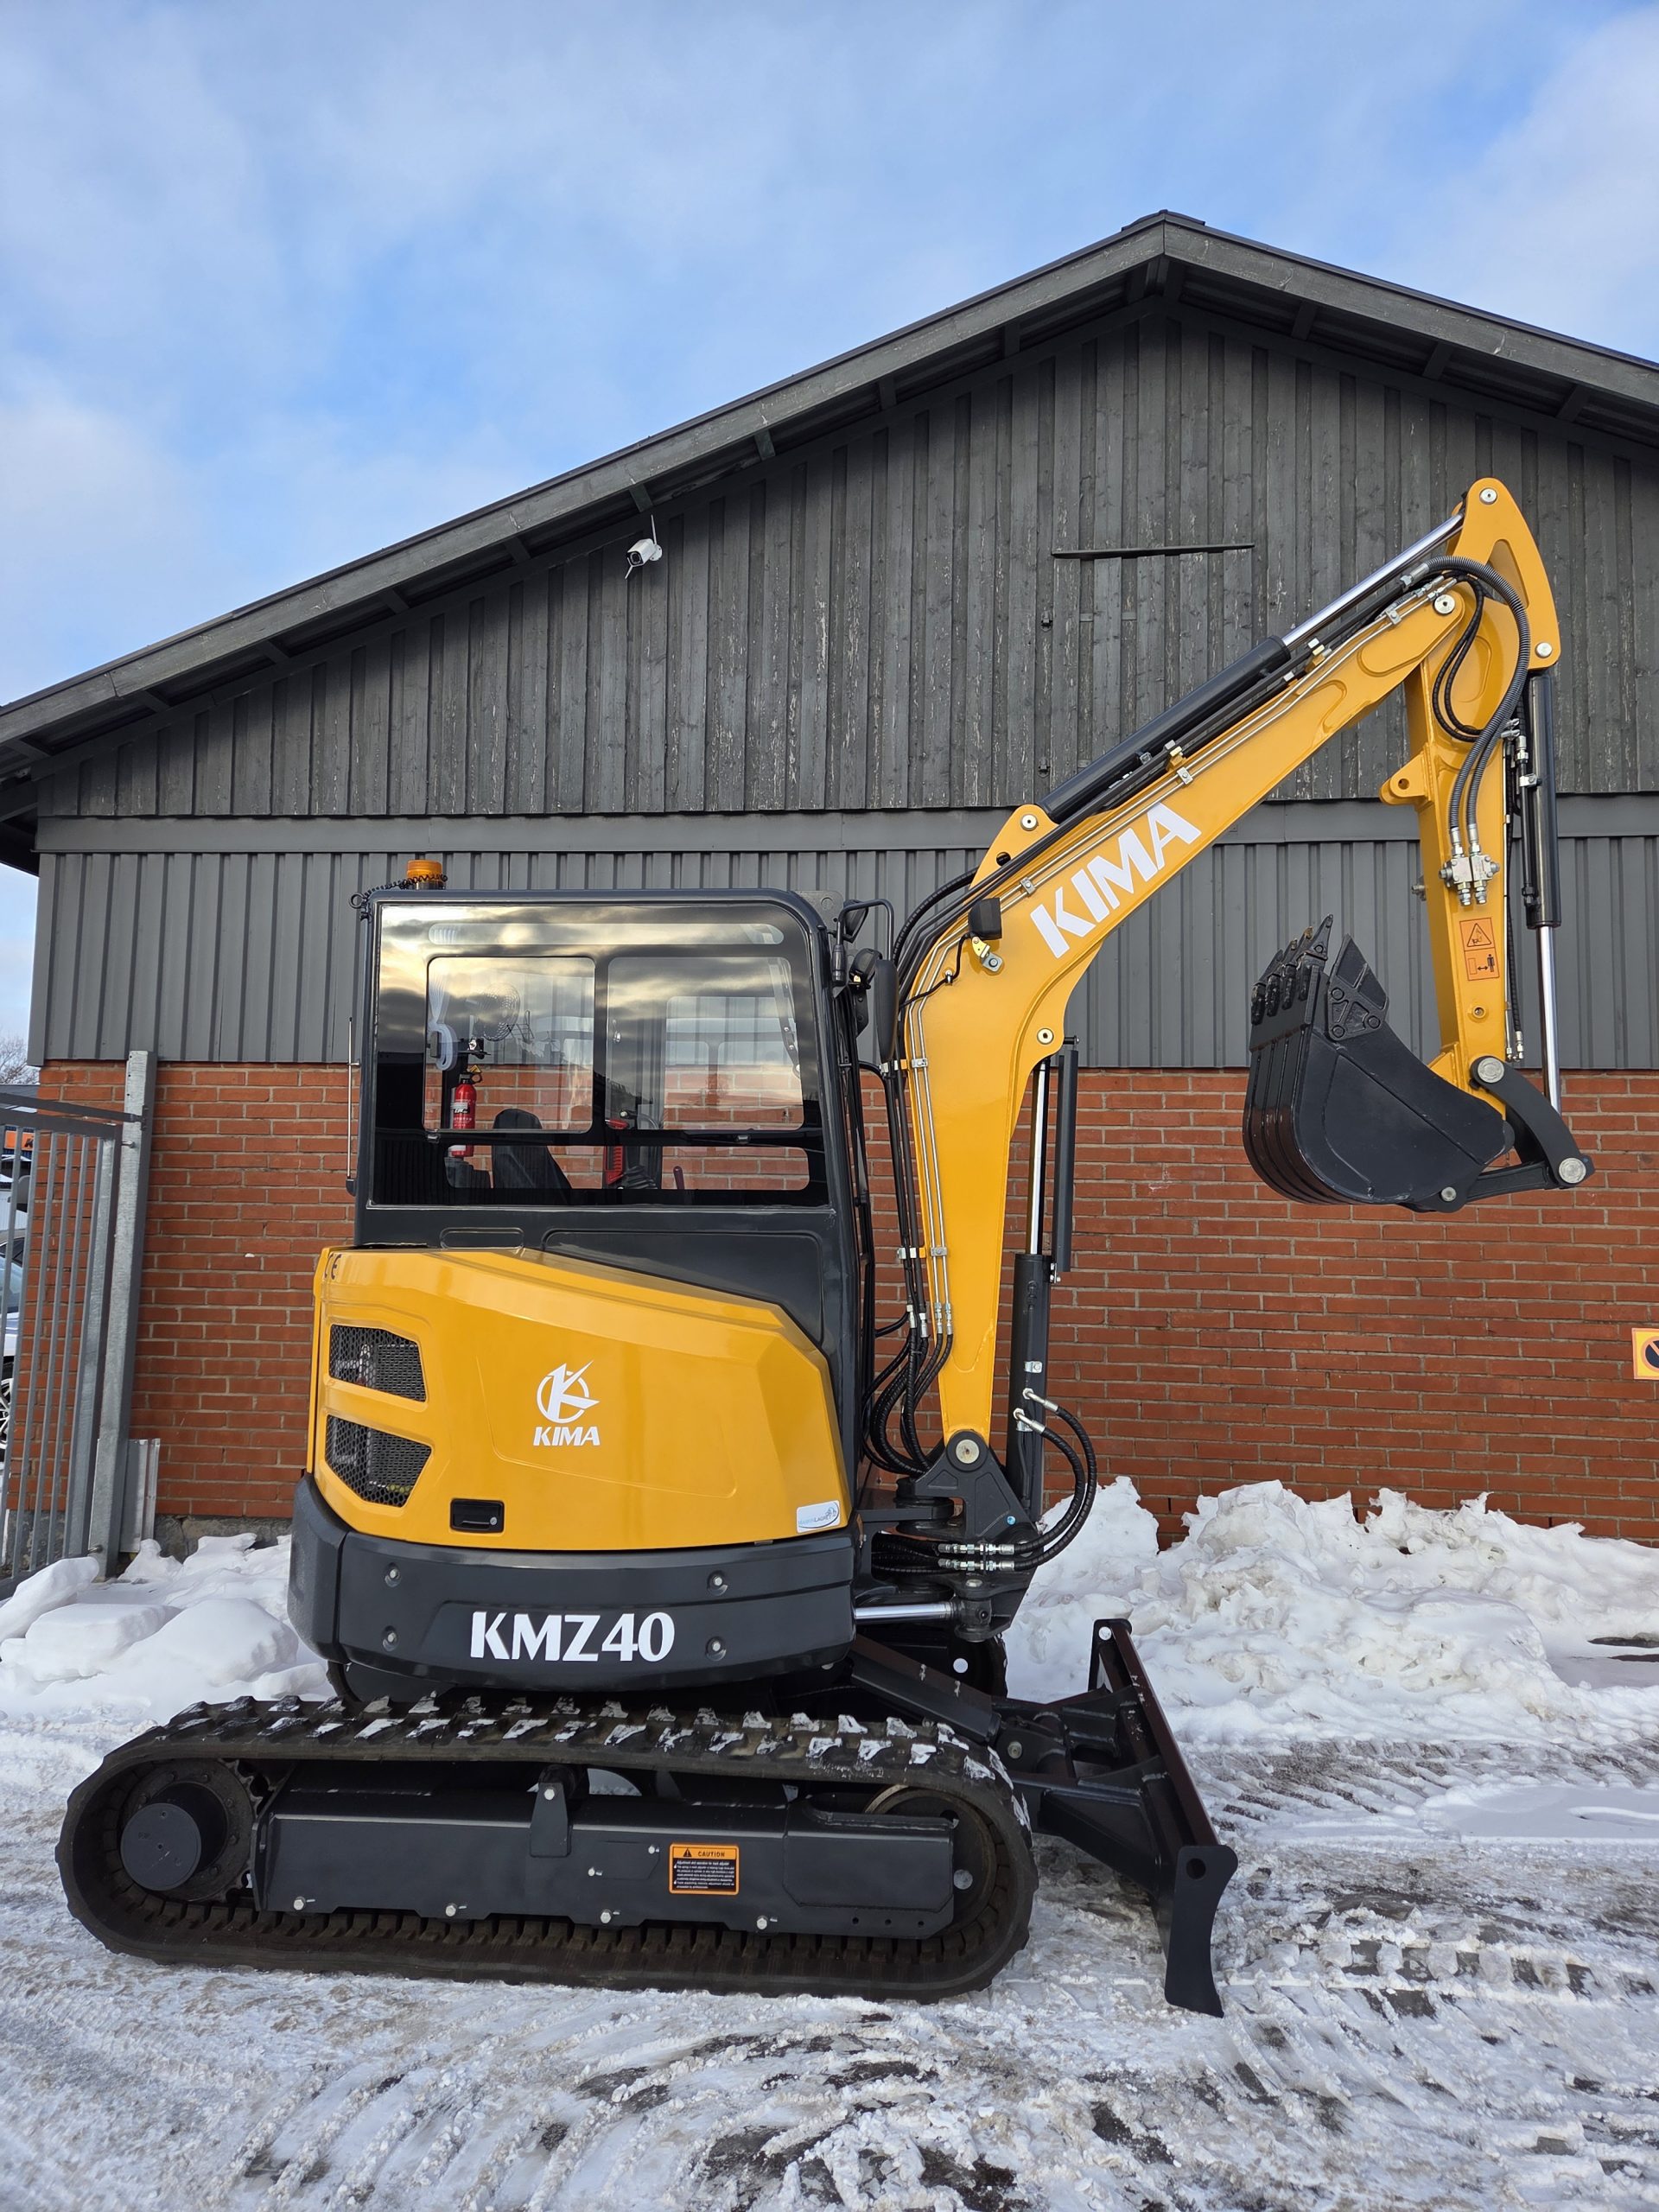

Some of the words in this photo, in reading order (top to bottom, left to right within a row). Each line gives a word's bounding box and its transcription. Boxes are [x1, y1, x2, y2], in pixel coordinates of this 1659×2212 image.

[1030, 802, 1202, 959] KIMA
[533, 1427, 601, 1446] KIMA
[470, 1611, 675, 1662] KMZ40
